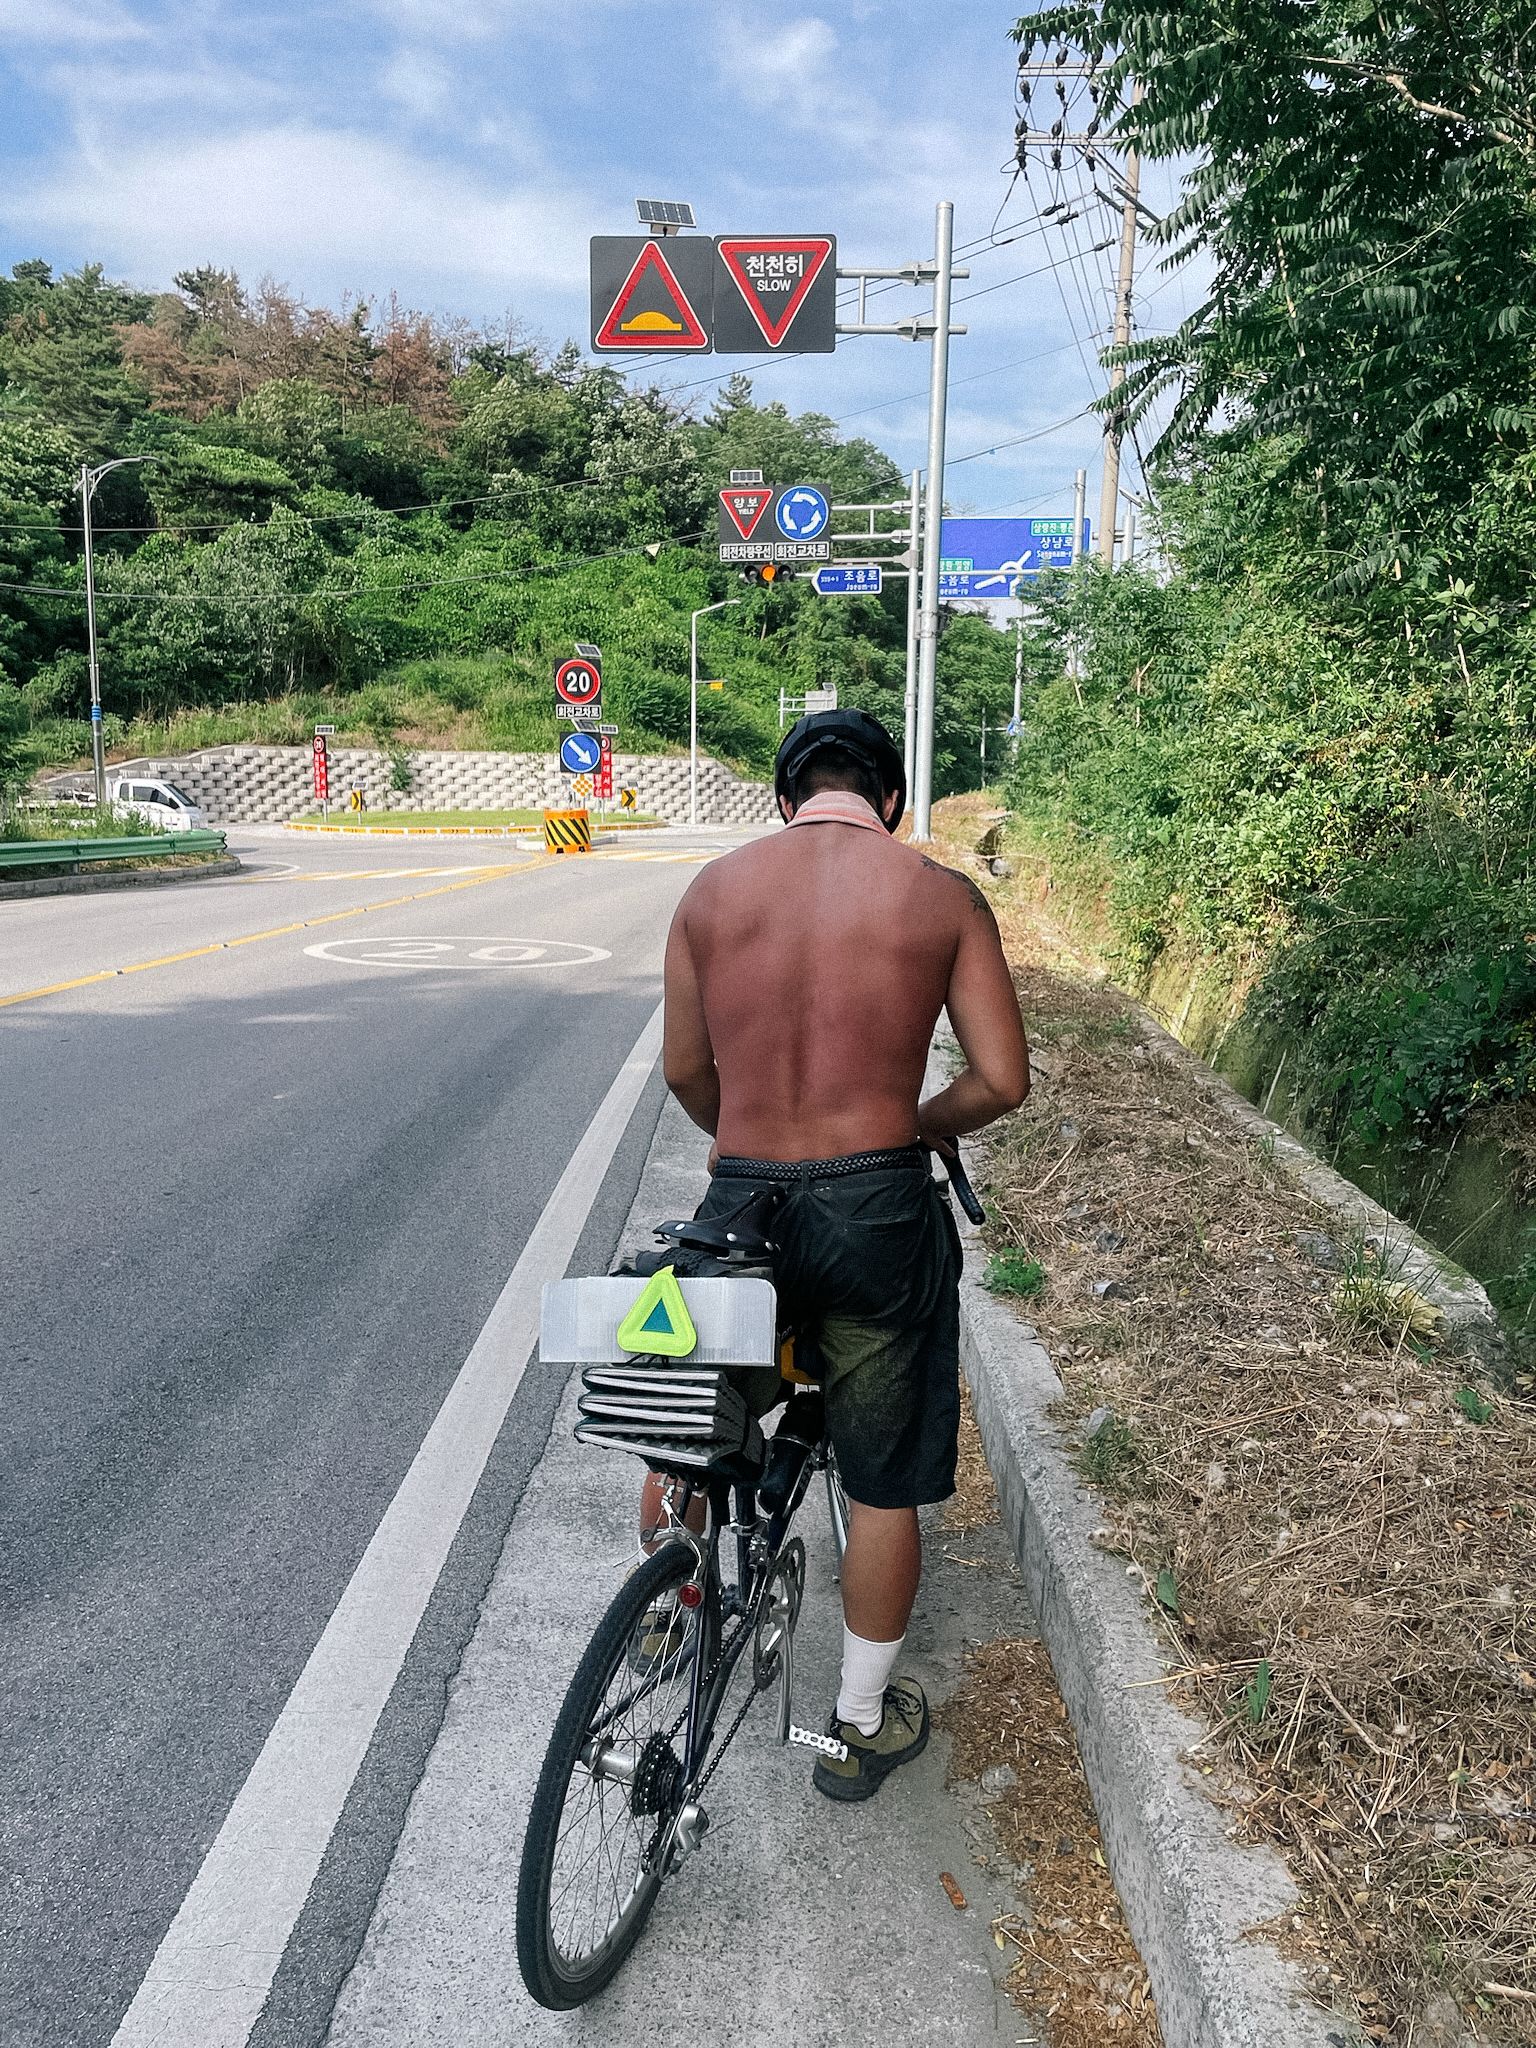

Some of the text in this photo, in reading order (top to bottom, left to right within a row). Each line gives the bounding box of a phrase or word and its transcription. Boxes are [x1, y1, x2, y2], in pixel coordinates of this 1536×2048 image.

[746, 254, 803, 277] 천천히
[757, 279, 791, 291] SLOW
[722, 545, 770, 558] 회전차량우선
[777, 544, 826, 557] 회전교차로
[844, 570, 877, 583] 조음로
[566, 671, 590, 692] 20
[558, 706, 599, 717] 회전교차로
[361, 942, 547, 961] 20
